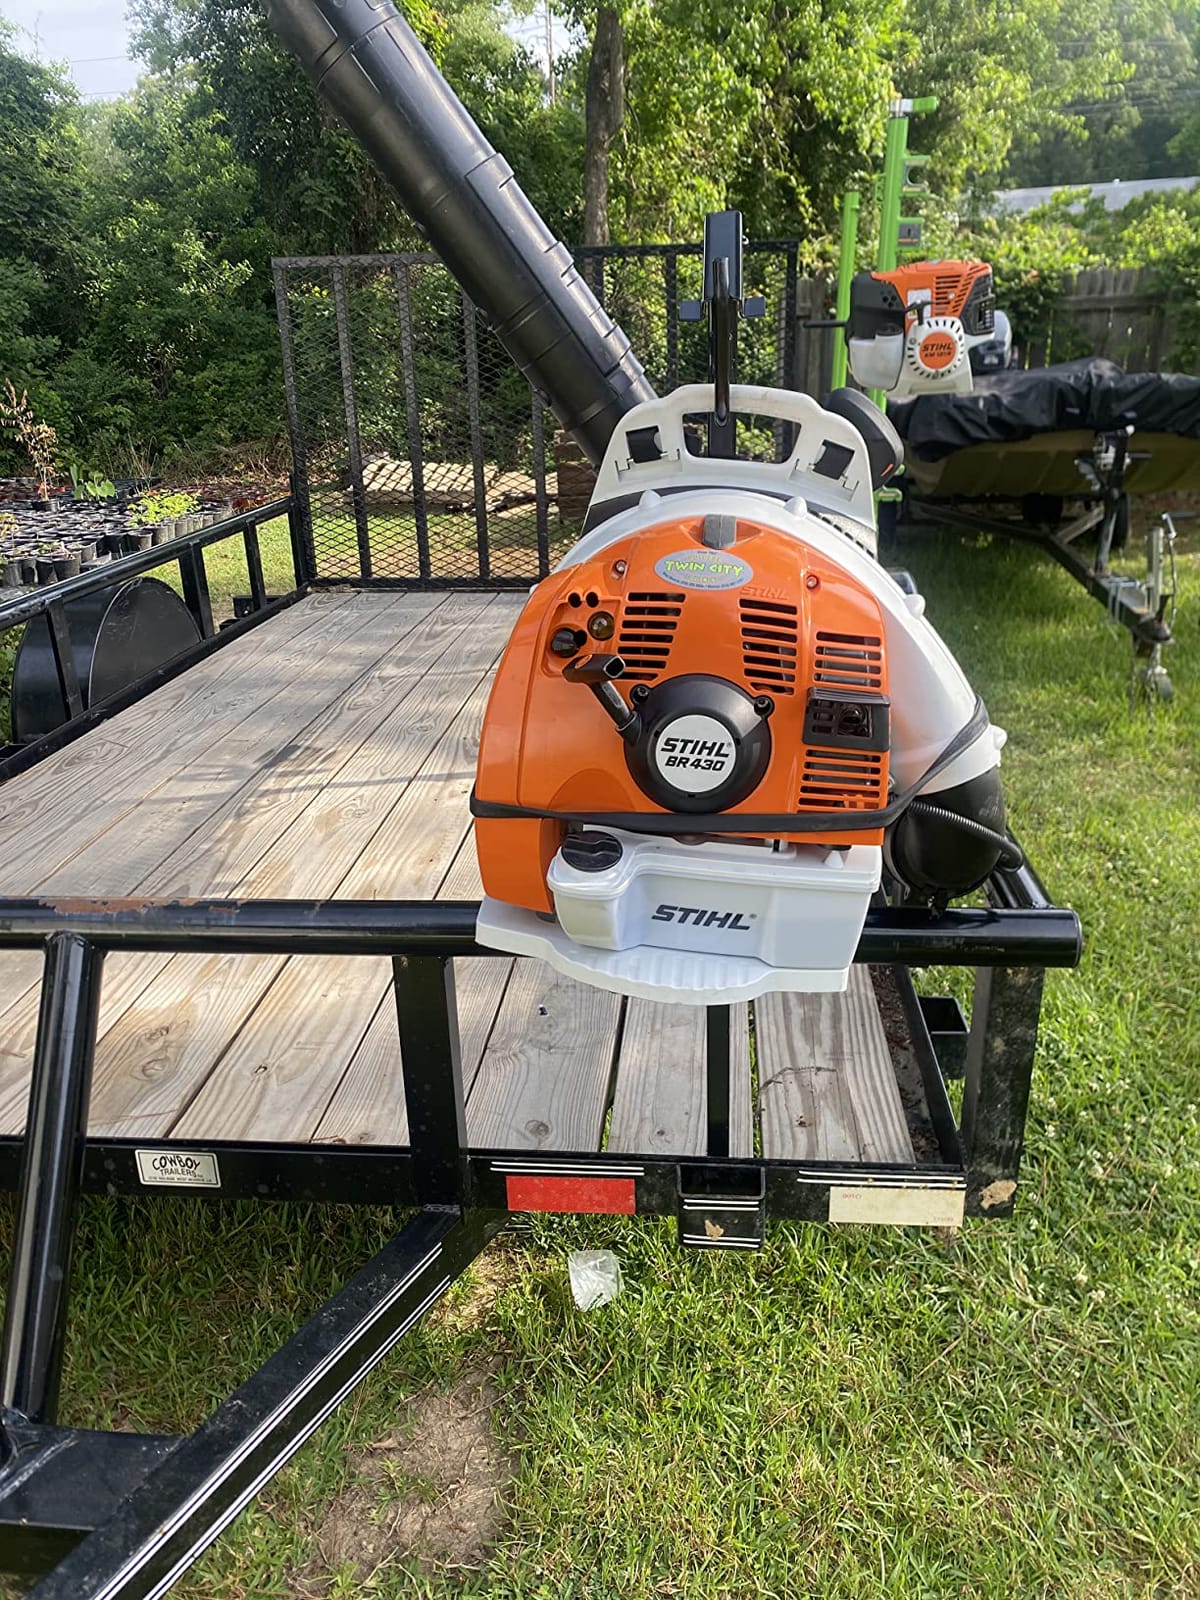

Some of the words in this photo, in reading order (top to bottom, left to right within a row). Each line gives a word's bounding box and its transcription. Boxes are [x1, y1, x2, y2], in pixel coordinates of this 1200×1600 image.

[665, 560, 705, 571] TWIN
[709, 564, 744, 577] CITY
[740, 585, 789, 601] STIHL
[660, 737, 729, 758] STIHL
[651, 904, 751, 931] STIHL
[152, 1155, 200, 1171] COWBOY
[160, 1168, 197, 1178] TRAILERS
